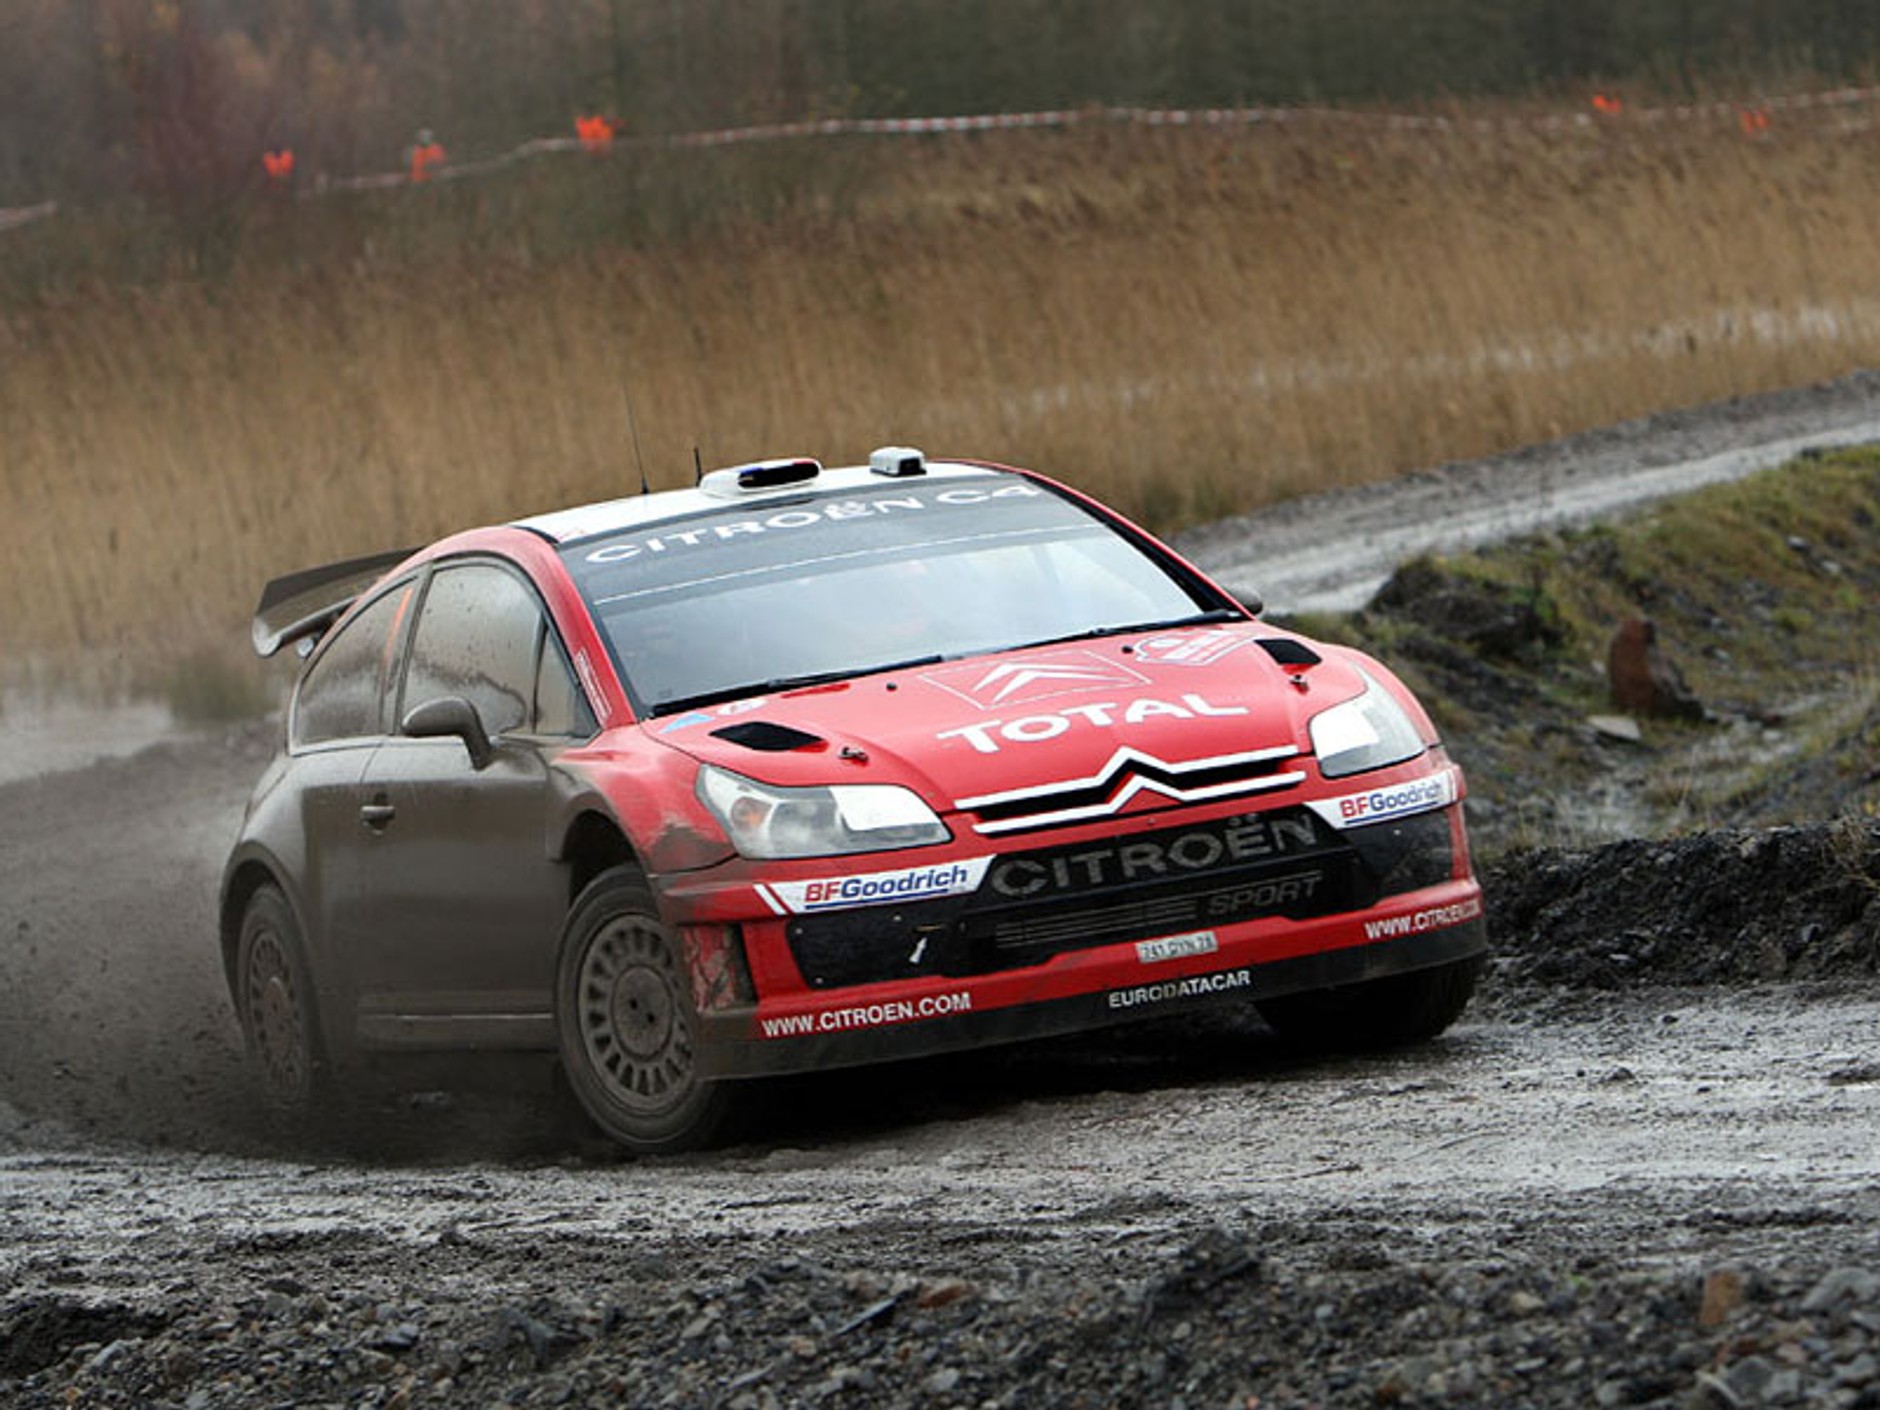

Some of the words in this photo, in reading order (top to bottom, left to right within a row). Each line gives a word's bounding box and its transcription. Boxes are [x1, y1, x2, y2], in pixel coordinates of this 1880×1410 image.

[585, 497, 925, 564] CITROËN
[937, 484, 1041, 505] C4
[935, 693, 1250, 753] TOTAL
[1339, 781, 1442, 818] BFGoodrich
[991, 812, 1318, 897] CITROËN
[804, 865, 968, 902] BFGoodrich
[1208, 875, 1323, 915] SPORT
[1108, 970, 1251, 1008] EURODATACAR
[762, 991, 972, 1038] WWW.CITROEN.COM
